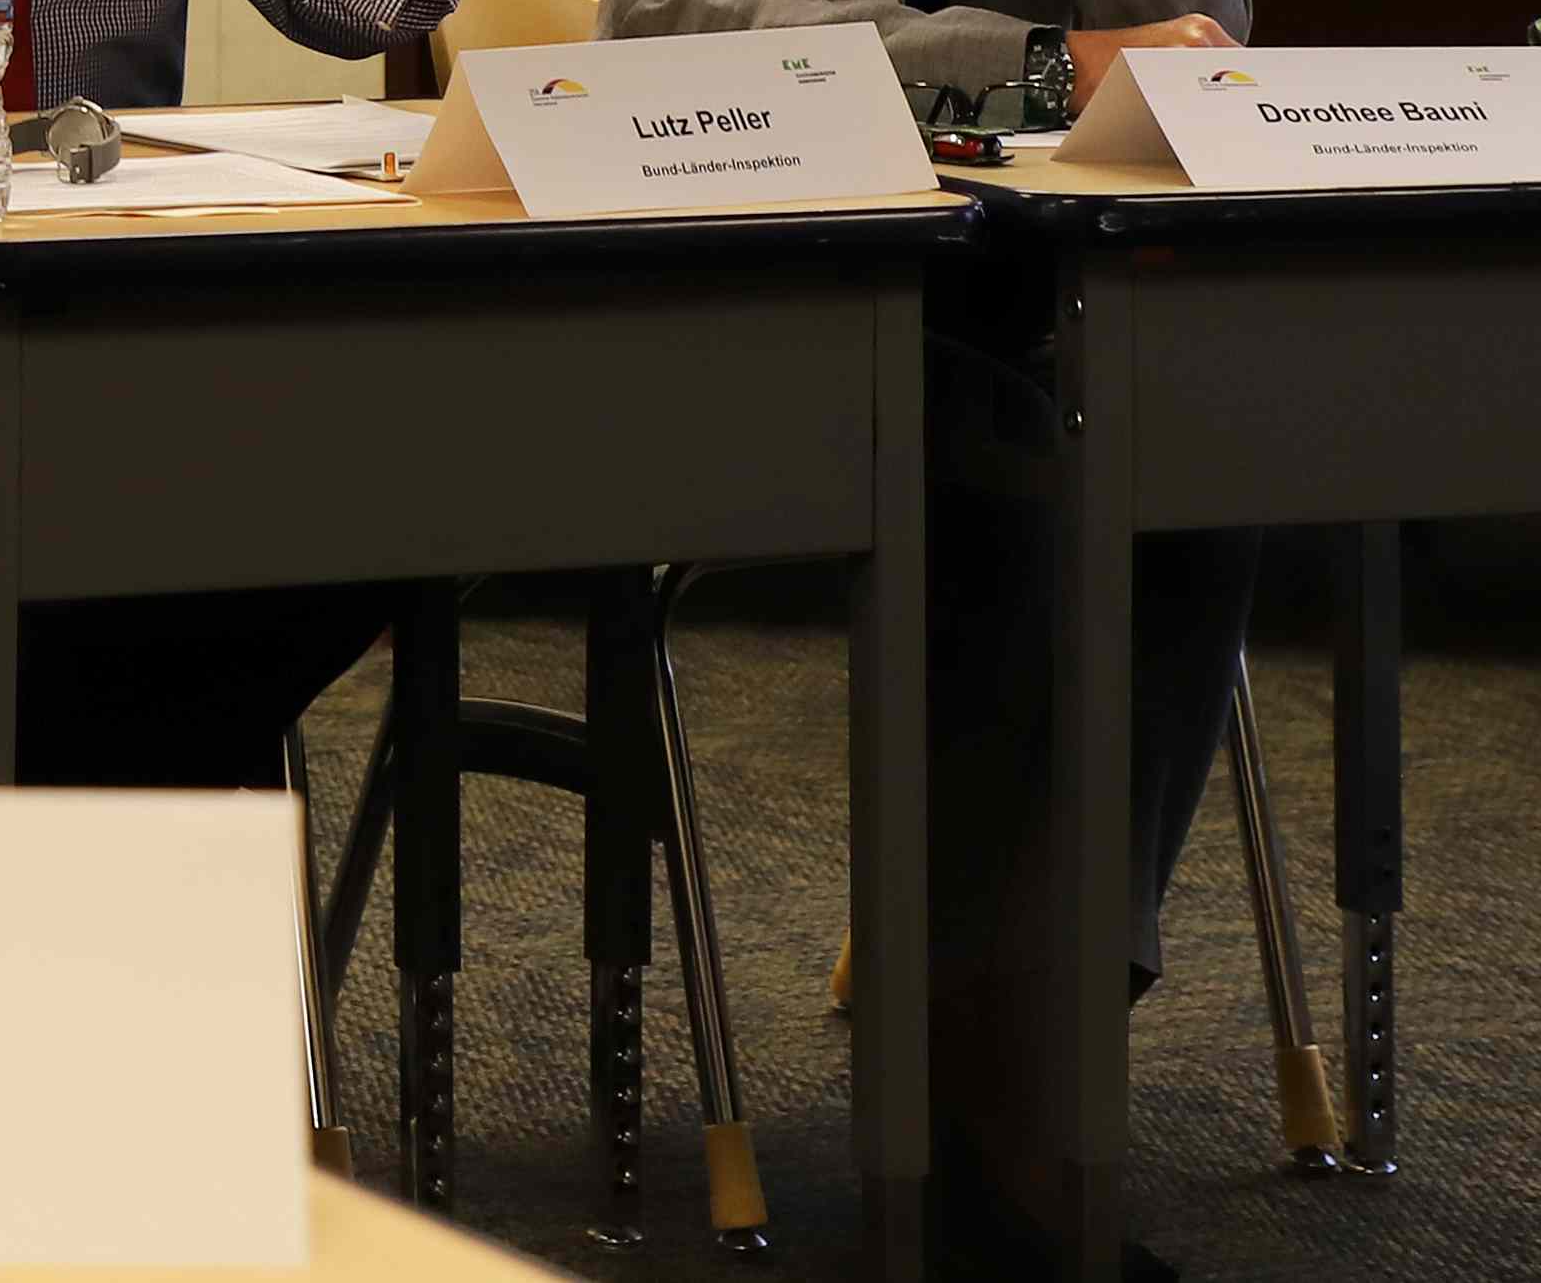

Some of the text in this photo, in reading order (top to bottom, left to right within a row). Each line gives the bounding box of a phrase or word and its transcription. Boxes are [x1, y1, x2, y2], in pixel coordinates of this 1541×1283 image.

[631, 107, 771, 139] Lutz Peller
[1256, 101, 1488, 123] Dorothee Bauni
[1312, 143, 1478, 156] Bund-Länder-Inspektion
[641, 154, 801, 178] Bund-Länder-Inspektion
